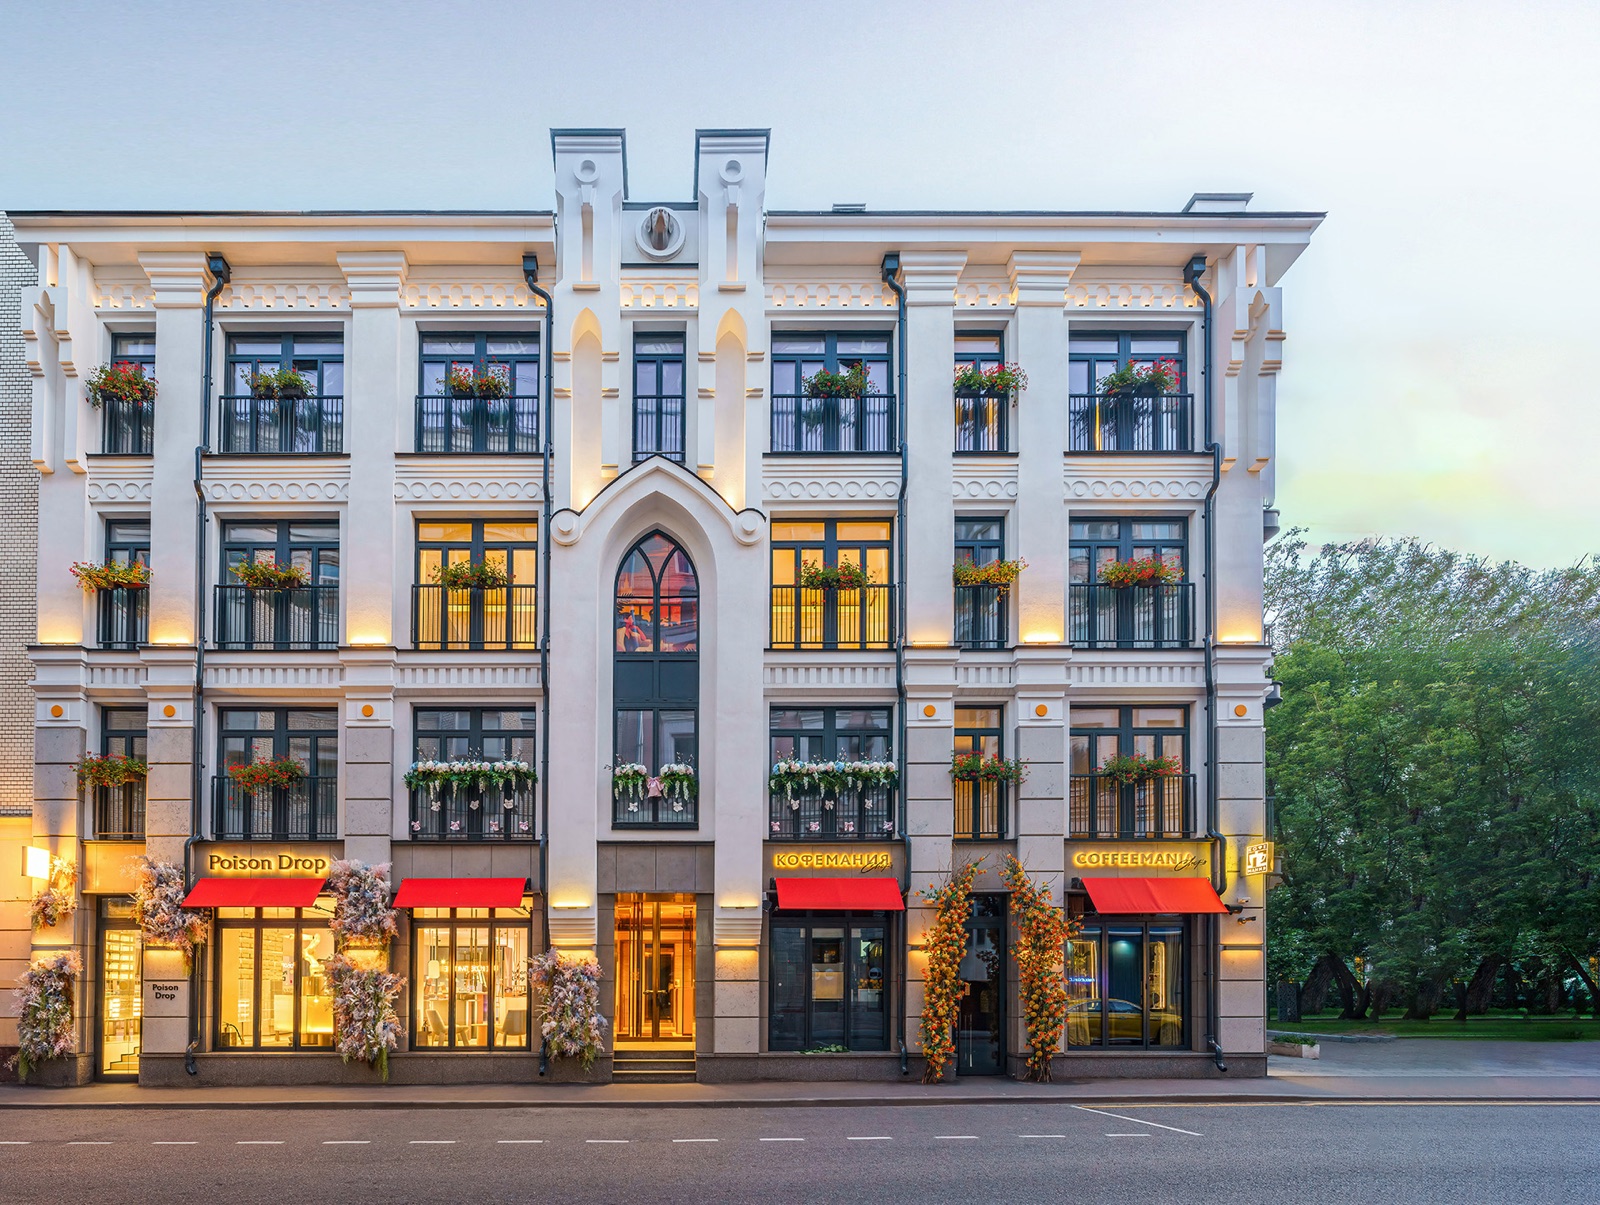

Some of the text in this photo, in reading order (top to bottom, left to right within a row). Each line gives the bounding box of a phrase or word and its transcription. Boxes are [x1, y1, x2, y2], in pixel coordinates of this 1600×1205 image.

[208, 854, 327, 874] Poison Drop
[775, 854, 889, 866] КОФЕМАНИЯ
[152, 983, 179, 991] Poison
[155, 991, 176, 1001] Drop
